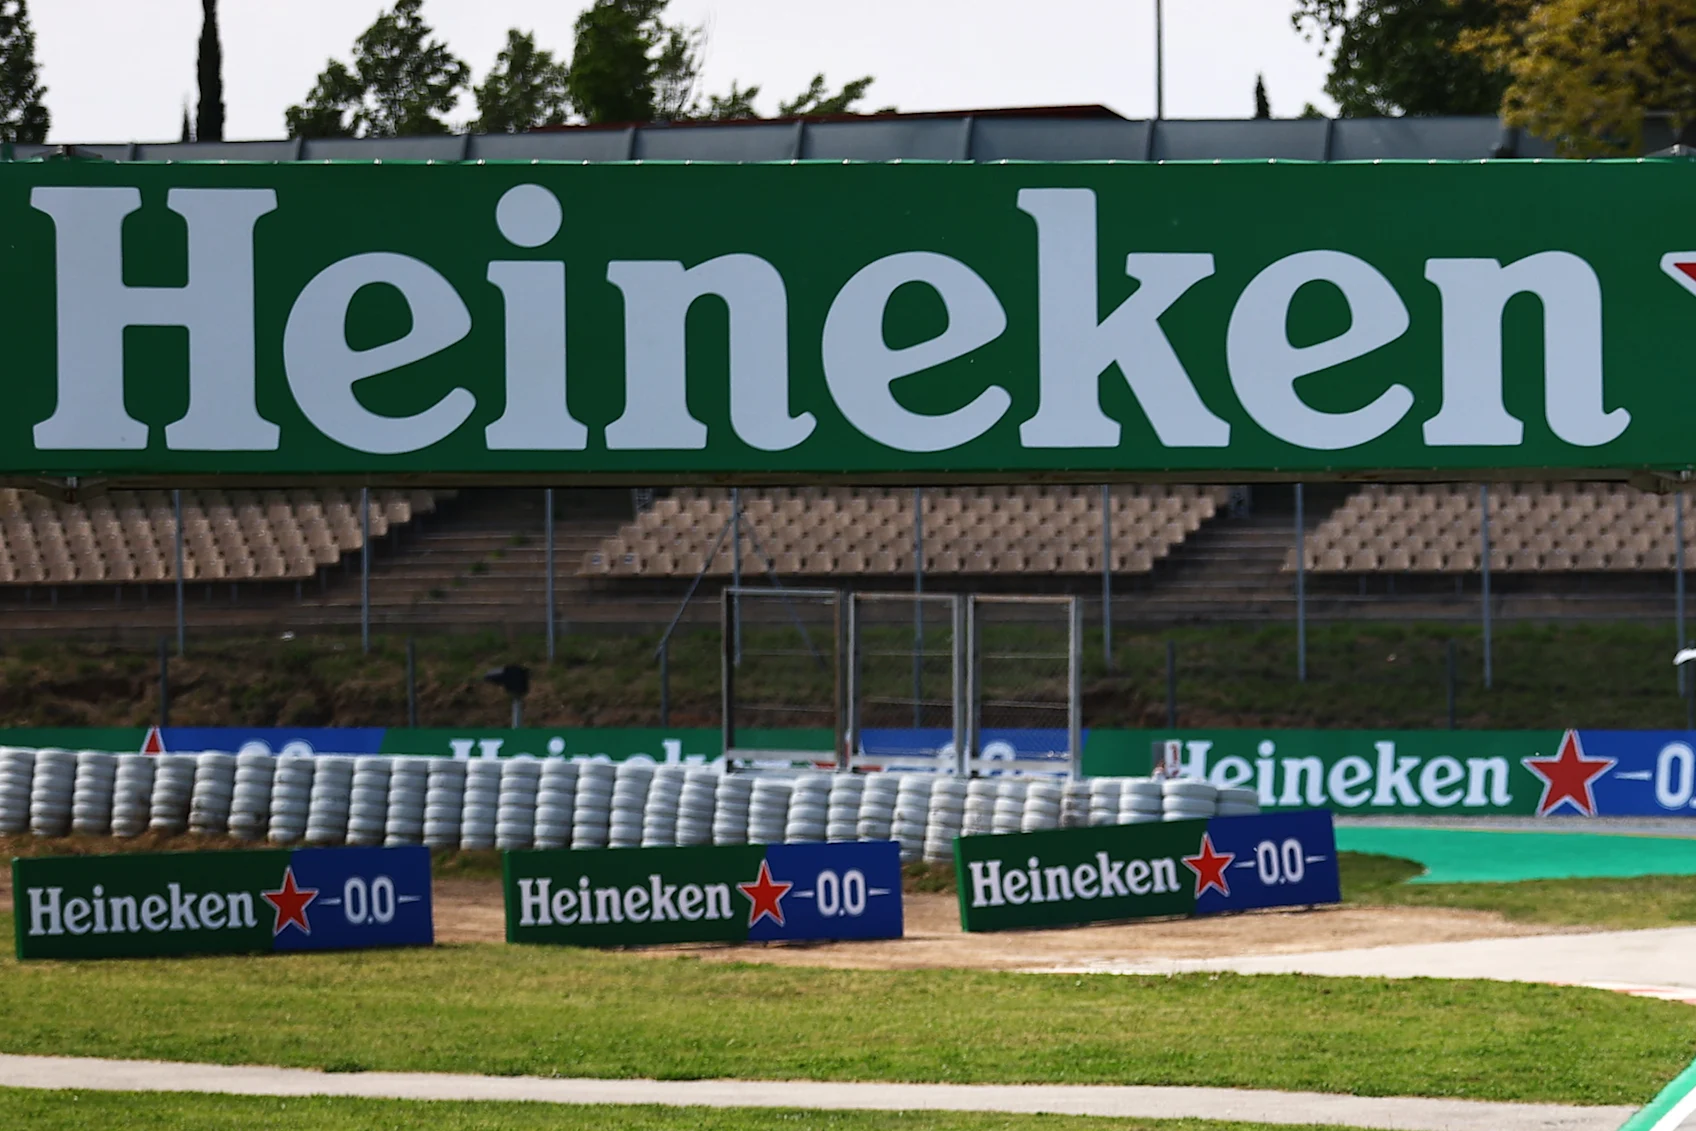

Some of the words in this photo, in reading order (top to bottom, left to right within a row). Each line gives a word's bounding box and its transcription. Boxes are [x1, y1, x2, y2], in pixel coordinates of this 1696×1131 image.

[30, 184, 1631, 455] Heineken
[517, 874, 733, 926] Heineken
[816, 869, 867, 916] 0.0
[969, 851, 1182, 908] Heineken
[1257, 838, 1304, 886] 0.0
[28, 883, 256, 935] Heineken
[344, 876, 395, 924] 0.0
